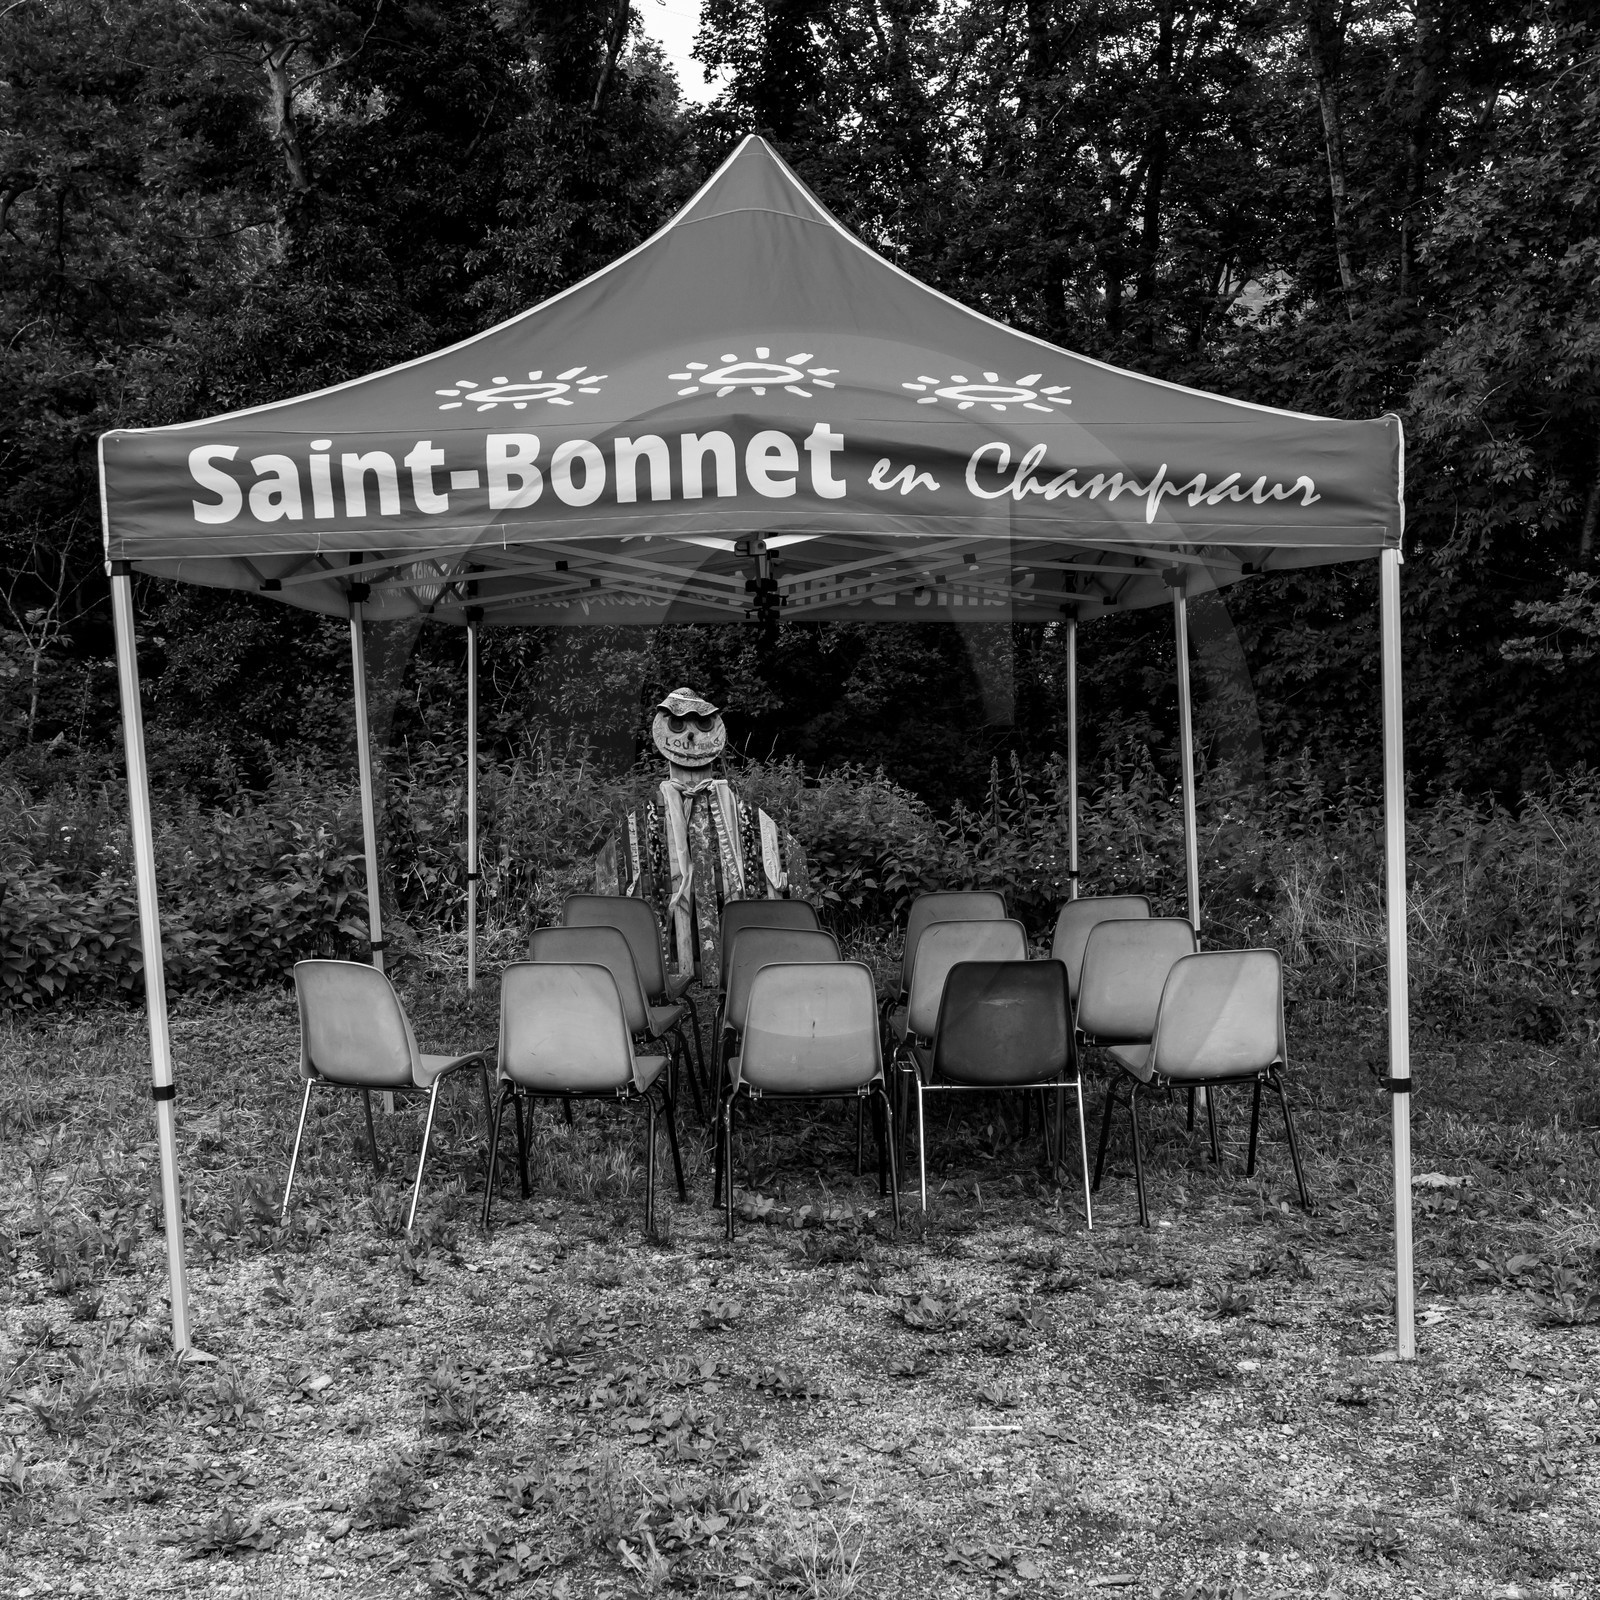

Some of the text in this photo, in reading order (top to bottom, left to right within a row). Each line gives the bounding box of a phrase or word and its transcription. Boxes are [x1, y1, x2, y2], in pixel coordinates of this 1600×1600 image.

[189, 423, 1321, 525] Saint-Bonnet en Champsaur
